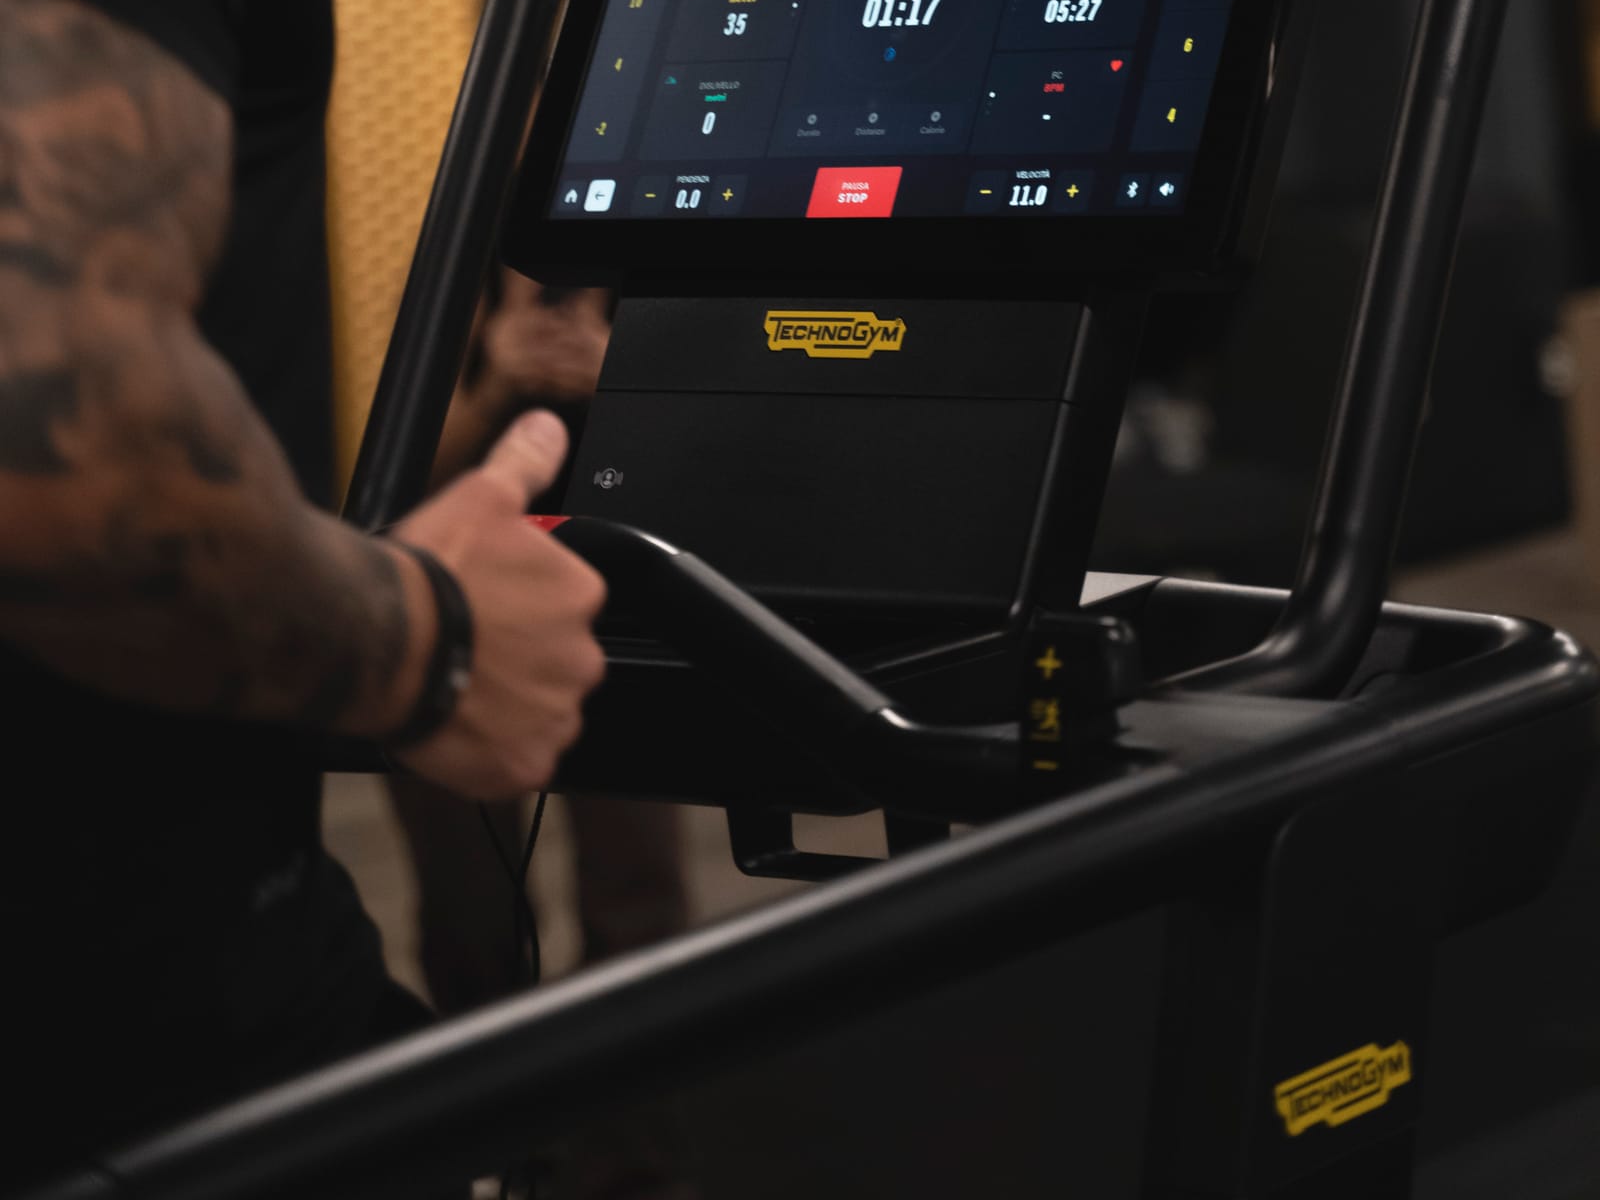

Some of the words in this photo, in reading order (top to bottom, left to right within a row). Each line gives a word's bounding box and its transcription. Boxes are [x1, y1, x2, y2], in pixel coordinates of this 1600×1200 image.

[723, 13, 748, 36] 35
[1183, 37, 1194, 53] 6
[702, 111, 716, 135] 0
[1166, 107, 1177, 123] 4
[841, 181, 870, 191] PAUSA
[1009, 185, 1048, 206] 11.0
[675, 189, 702, 209] 0.0
[837, 192, 868, 203] STOP
[768, 317, 900, 349] TECHNOGYM
[1279, 1051, 1404, 1119] TECHNOGYM
